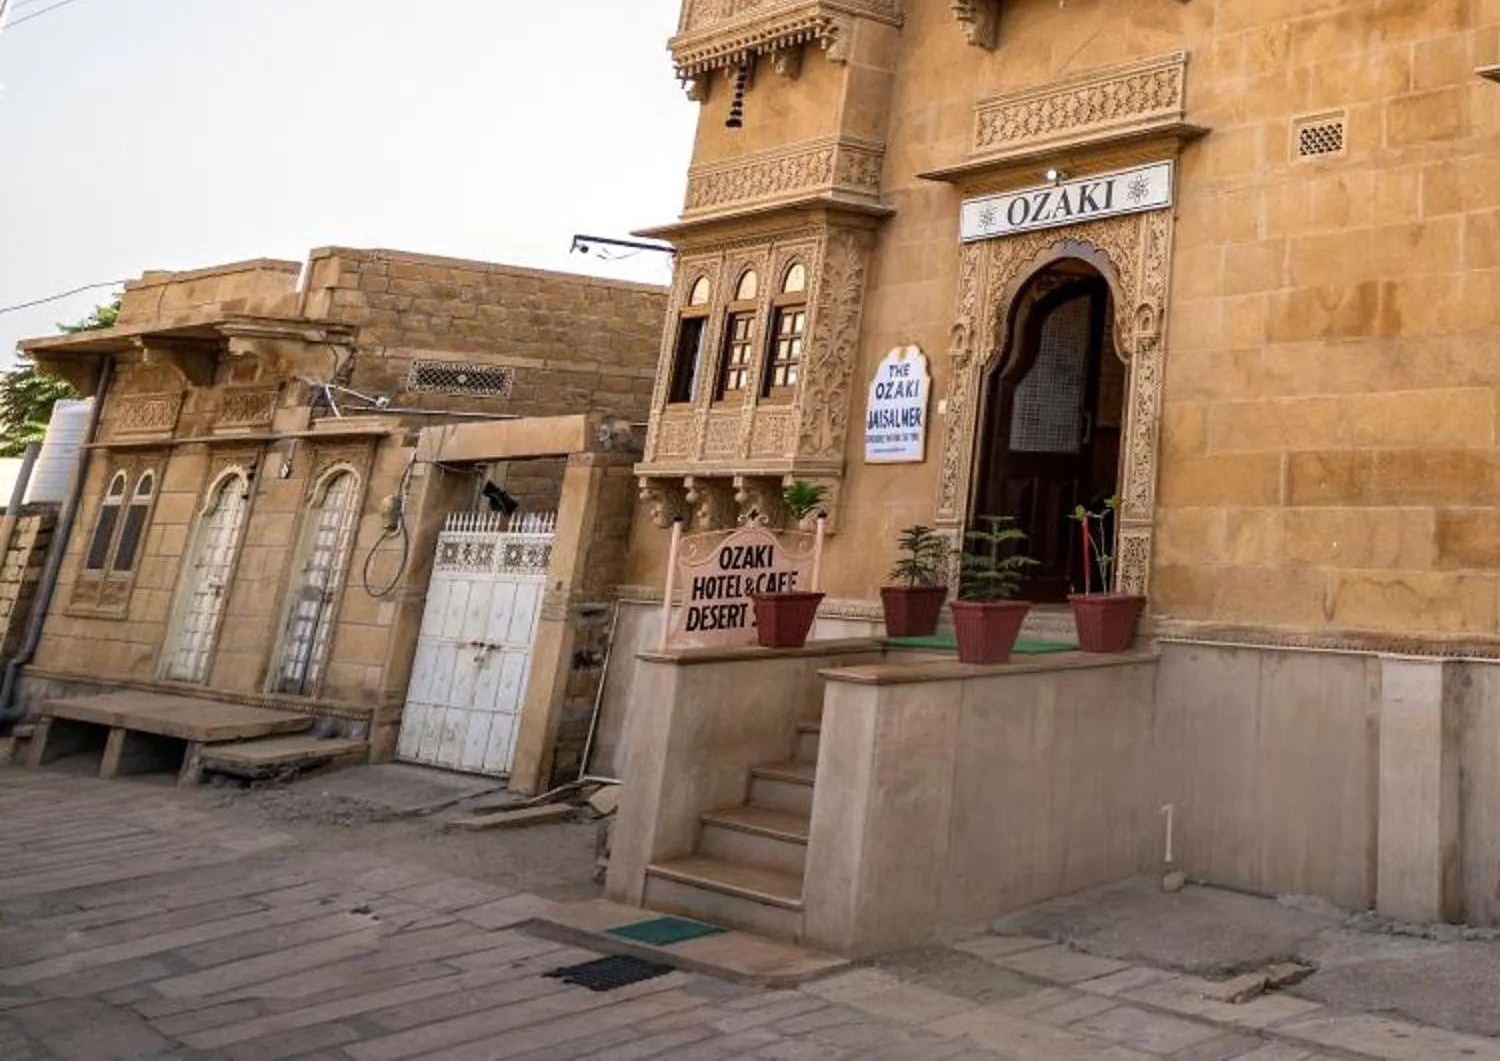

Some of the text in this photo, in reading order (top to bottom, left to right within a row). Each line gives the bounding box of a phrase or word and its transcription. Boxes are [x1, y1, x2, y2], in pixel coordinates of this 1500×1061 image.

[1007, 180, 1116, 226] OZAKI
[888, 363, 911, 378] THE
[875, 379, 920, 400] OZAKI
[867, 407, 922, 430] JAISALMER
[719, 545, 774, 570] OZAKI
[691, 574, 743, 601] HOTEL
[686, 602, 749, 632] DESERT
